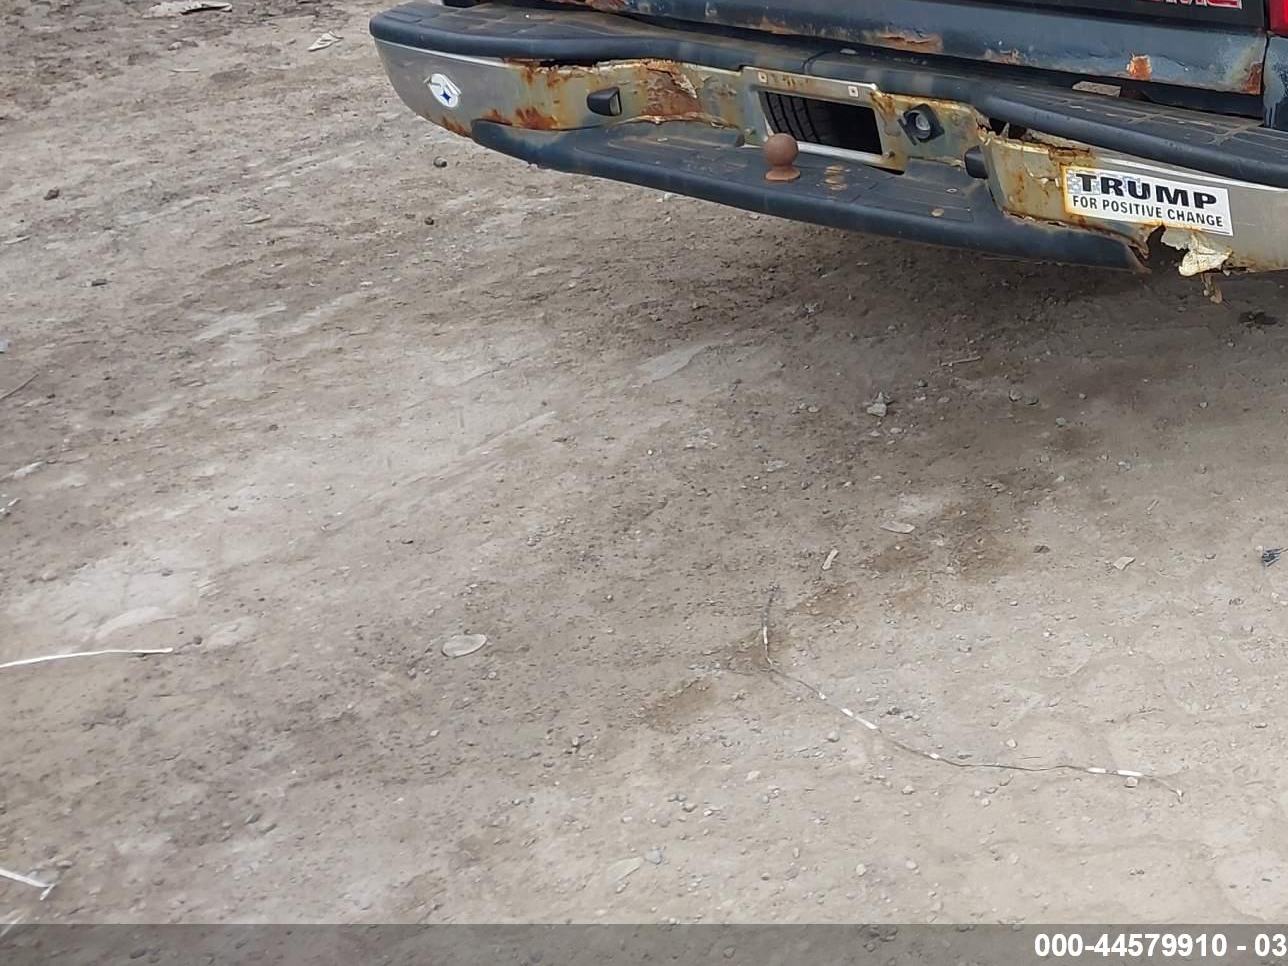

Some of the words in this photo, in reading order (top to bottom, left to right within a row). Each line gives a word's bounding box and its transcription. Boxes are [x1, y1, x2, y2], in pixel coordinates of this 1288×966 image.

[1075, 173, 1217, 209] TRUMP
[1072, 195, 1098, 210] FOR
[1102, 199, 1163, 219] POSITIVE
[1167, 208, 1224, 227] CHANGE
